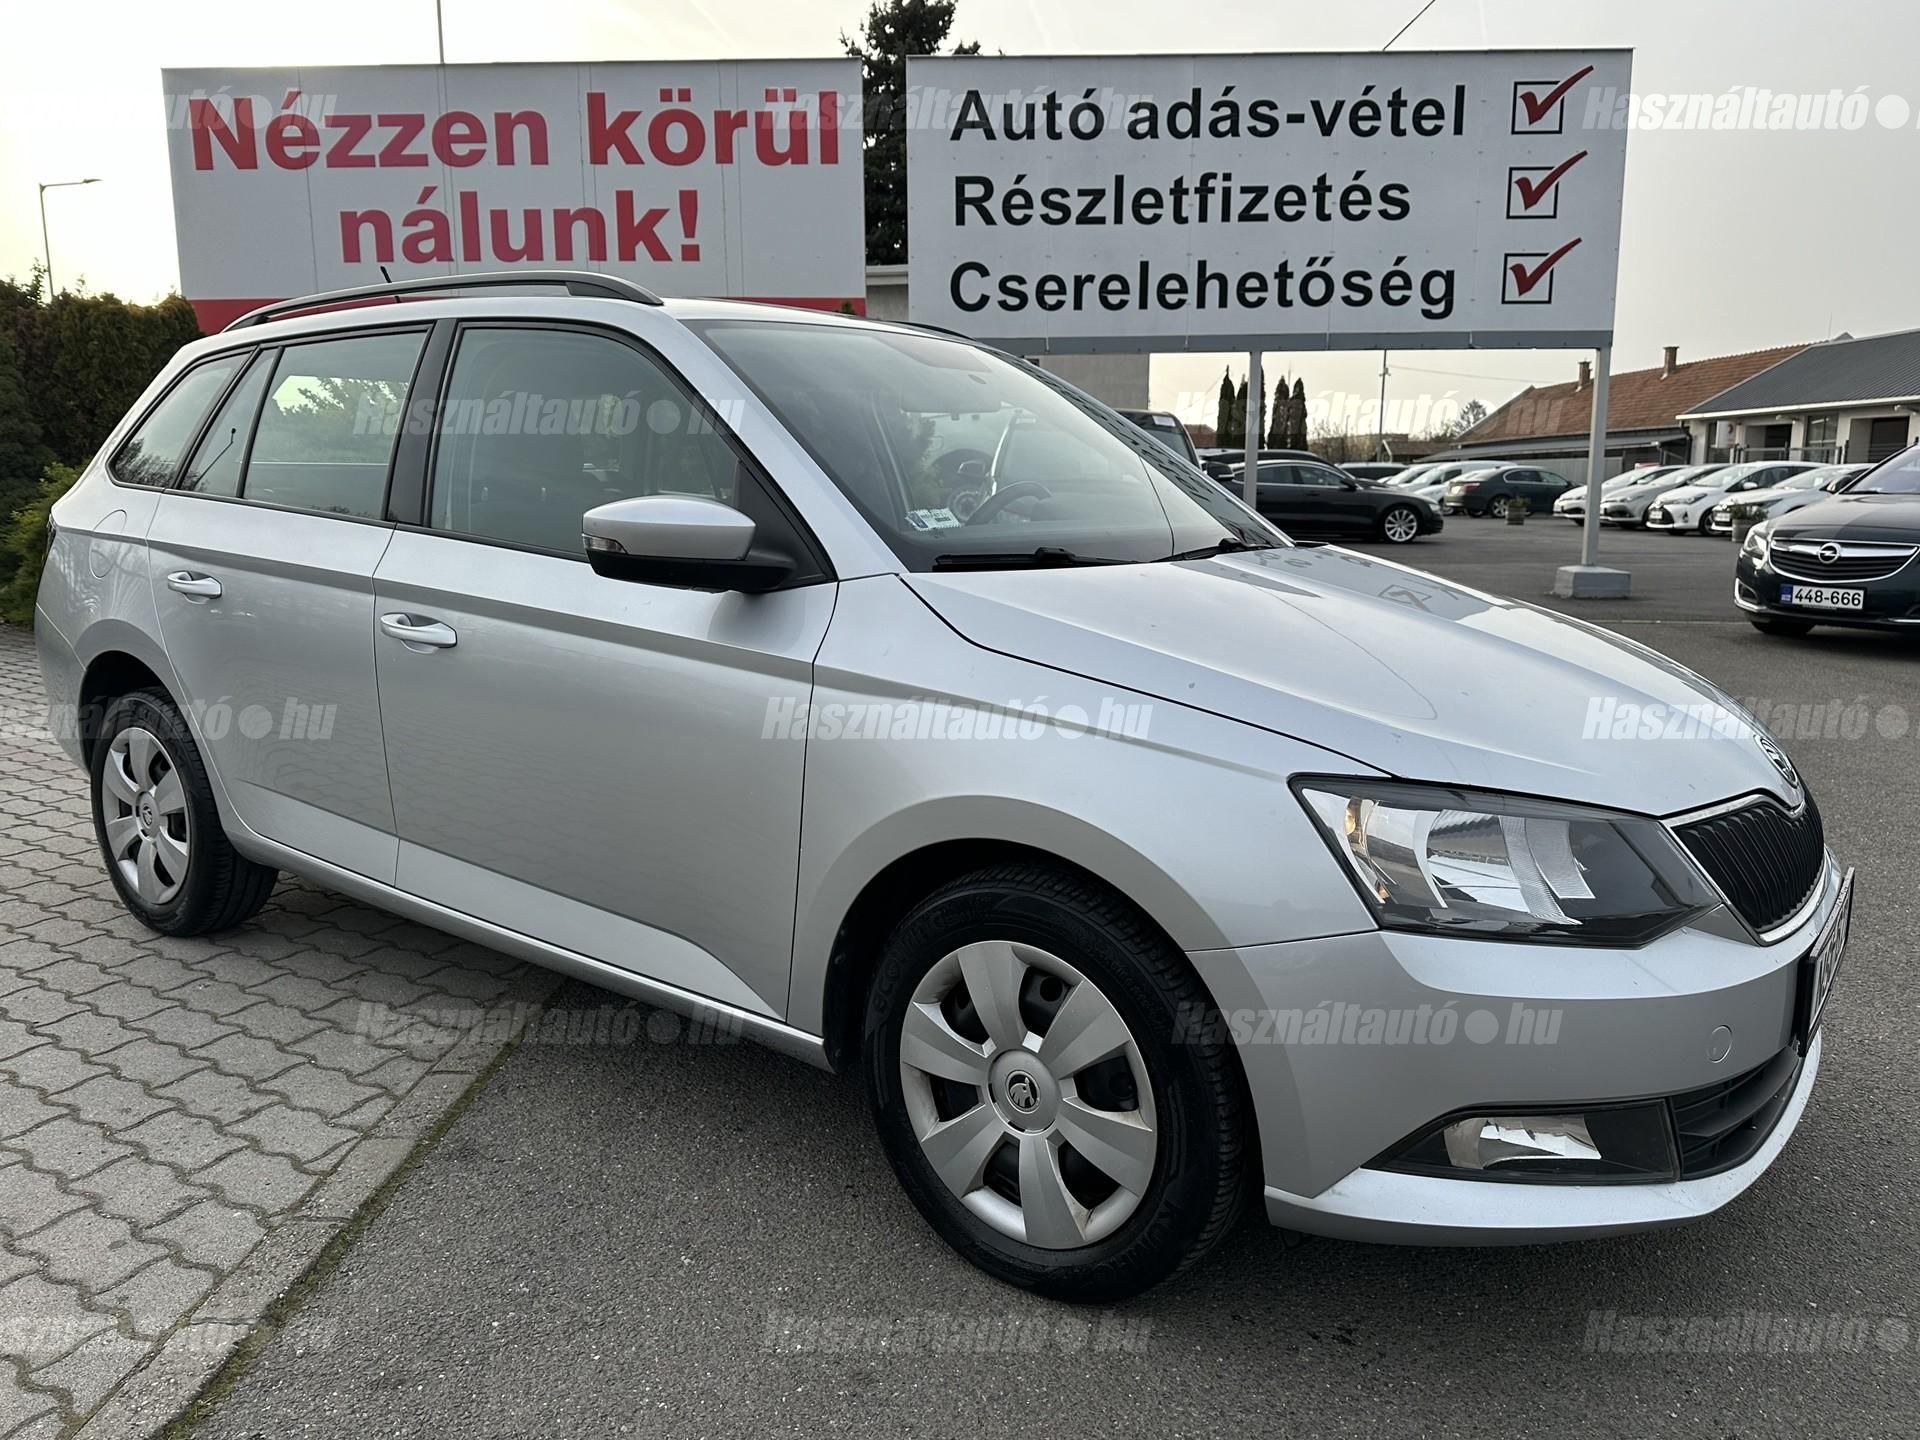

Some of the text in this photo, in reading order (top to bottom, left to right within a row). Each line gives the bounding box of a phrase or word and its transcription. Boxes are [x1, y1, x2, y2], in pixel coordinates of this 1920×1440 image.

[190, 91, 549, 171] Nézzen
[587, 88, 839, 165] körül
[950, 84, 1467, 141] Autó adás-vétel
[340, 186, 701, 264] nálunk!
[954, 168, 1411, 227] Részletfizetés
[949, 254, 1456, 320] Cserelehetőség
[1794, 587, 1863, 607] 448-666
